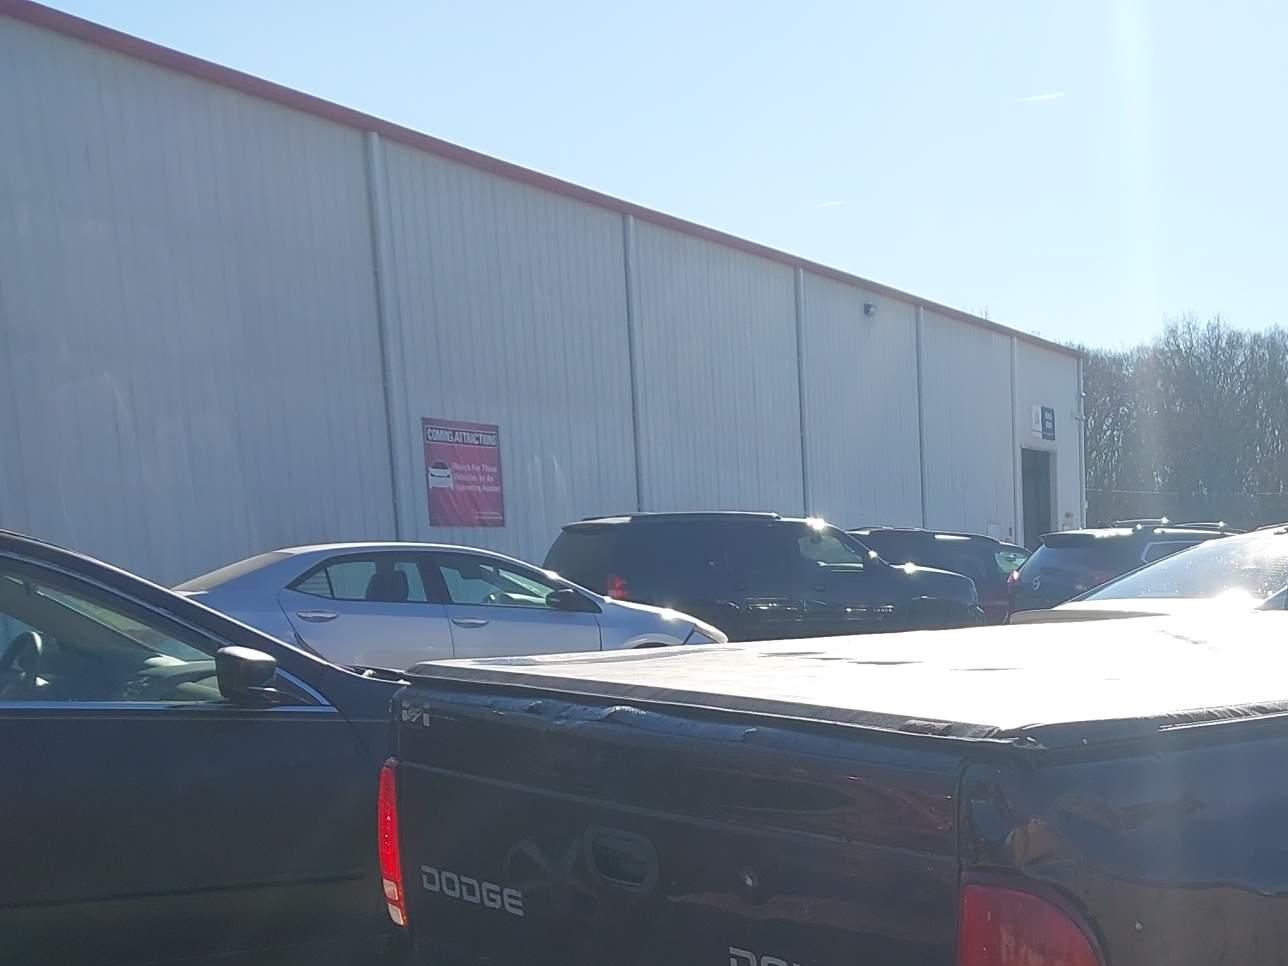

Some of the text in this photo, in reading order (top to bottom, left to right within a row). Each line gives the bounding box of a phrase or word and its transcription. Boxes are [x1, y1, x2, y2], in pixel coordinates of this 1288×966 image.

[427, 428, 497, 446] COMING ATTRACTIONS
[421, 865, 524, 916] DODGE
